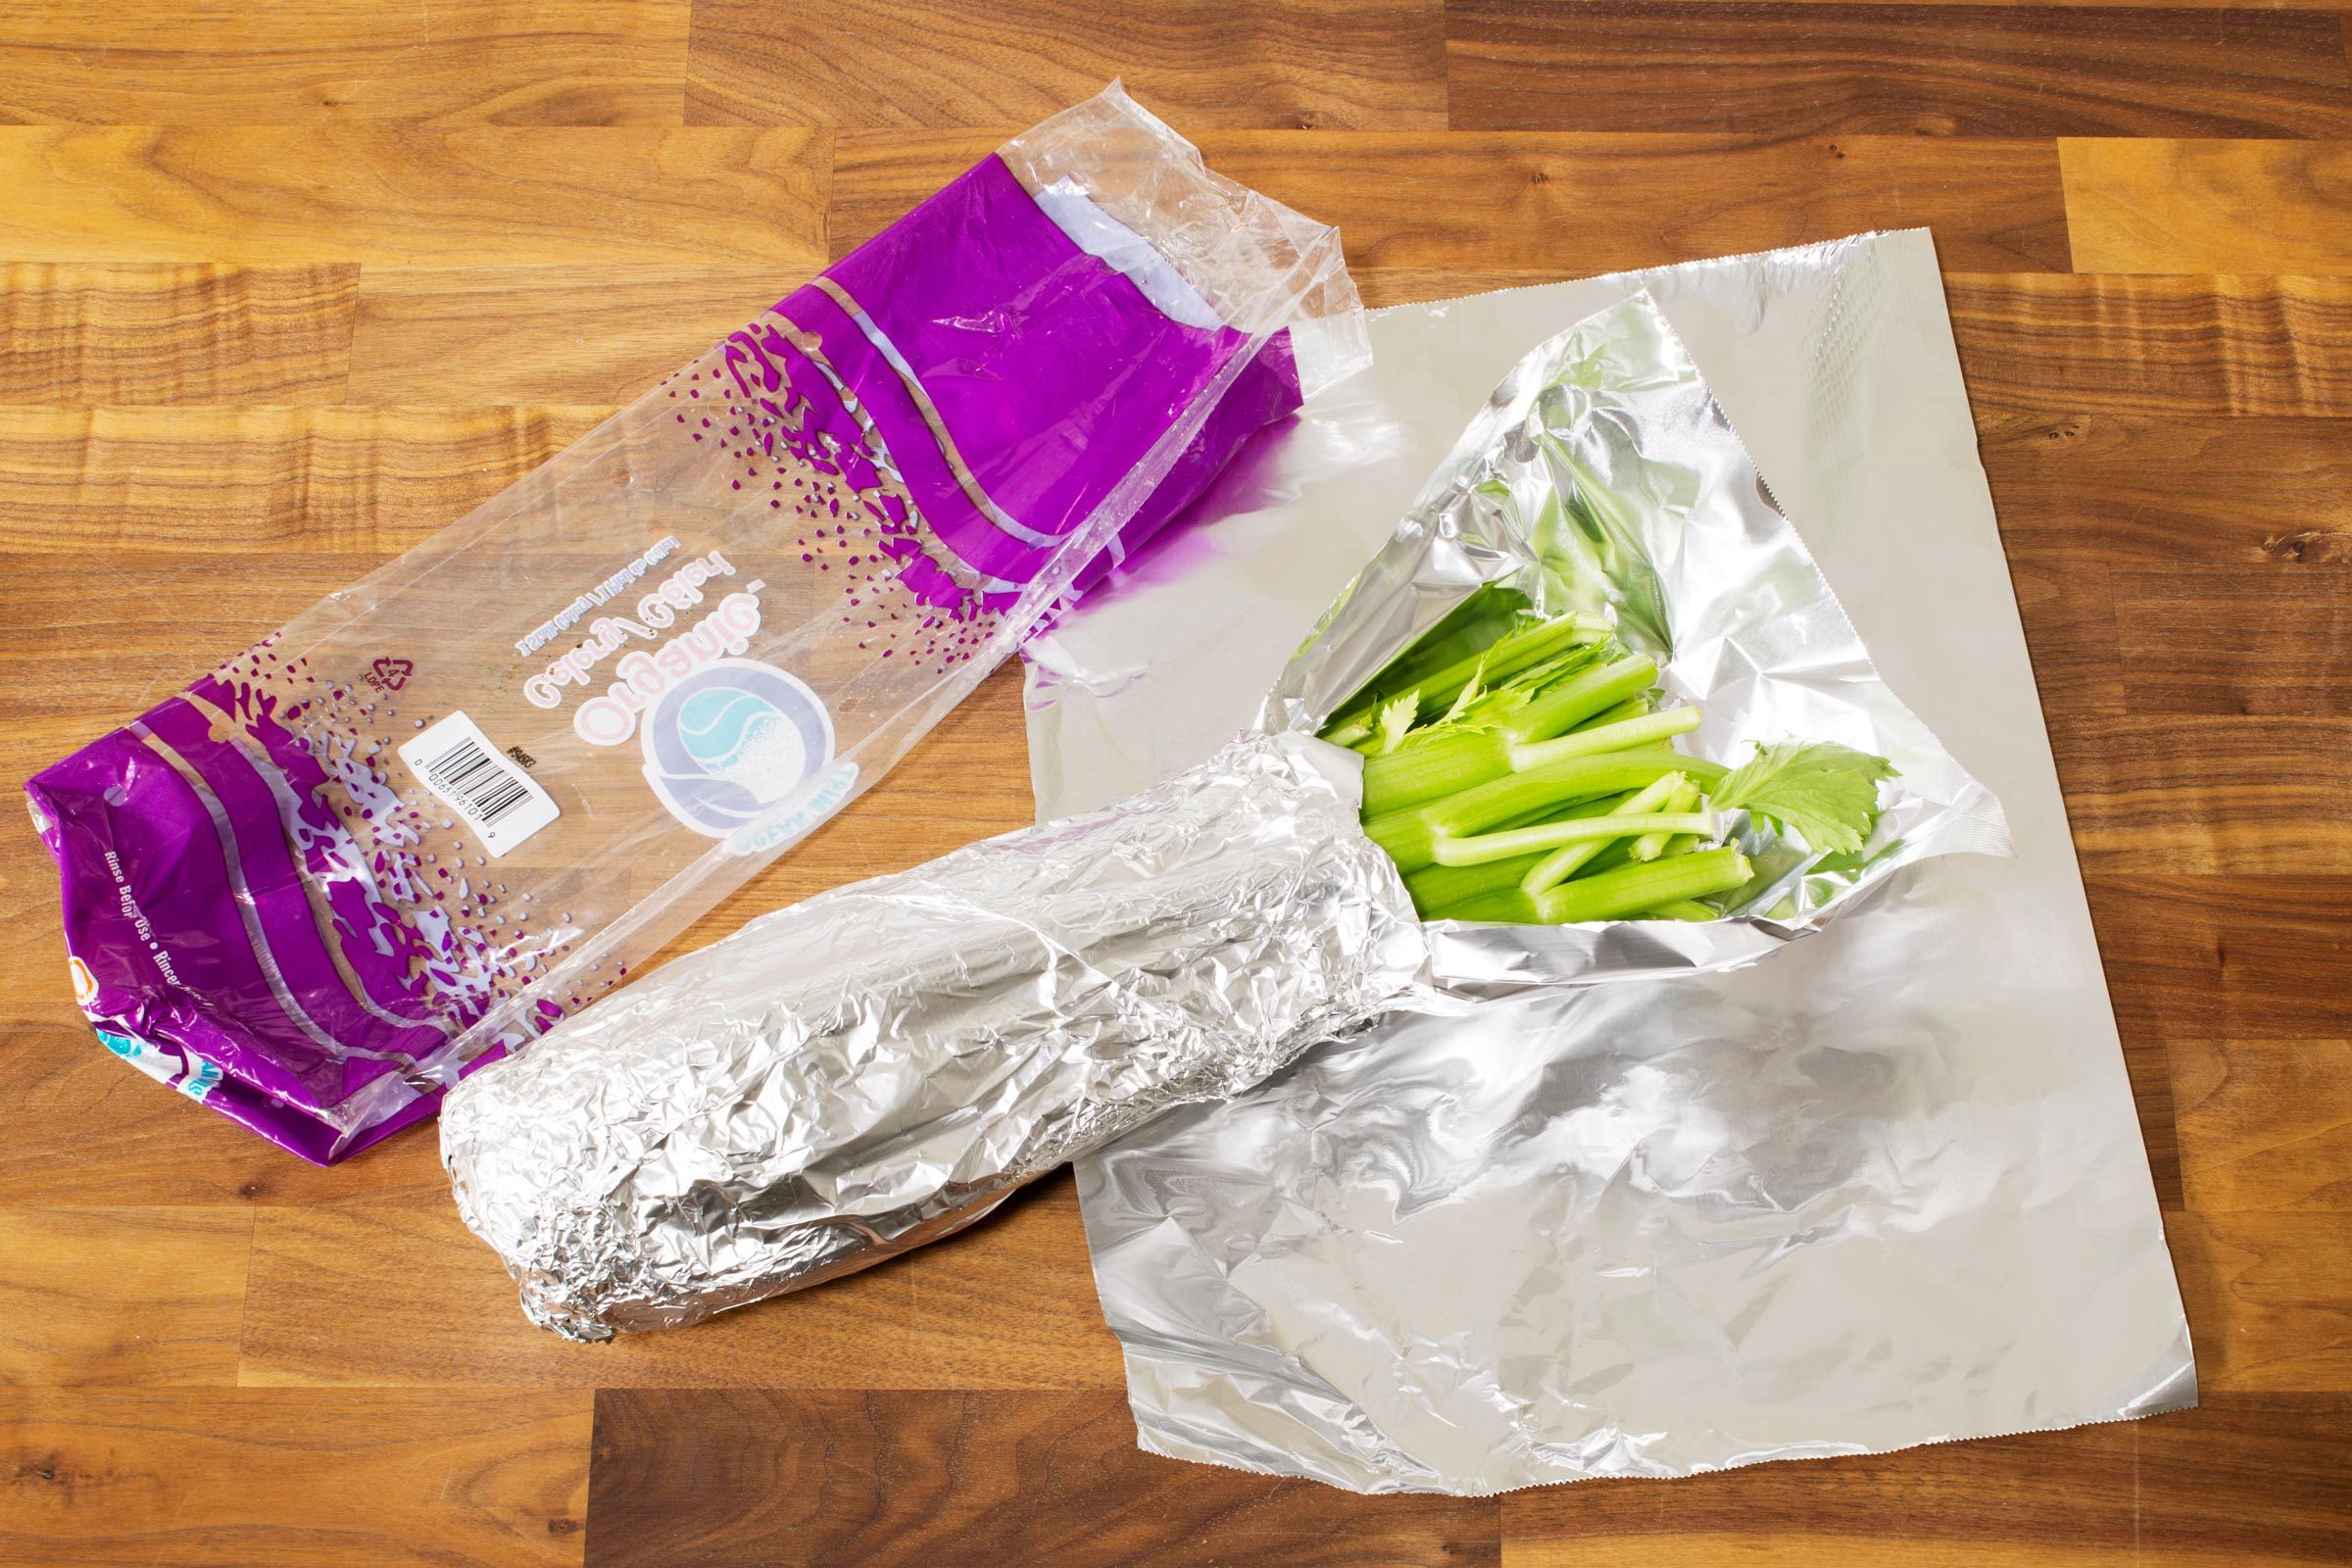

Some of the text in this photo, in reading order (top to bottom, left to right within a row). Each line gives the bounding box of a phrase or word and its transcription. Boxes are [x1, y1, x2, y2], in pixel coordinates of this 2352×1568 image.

[364, 672, 385, 693] LDPE
[387, 668, 399, 677] 4
[105, 851, 124, 883] Rinse
[135, 918, 151, 941] Use
[153, 951, 180, 985] Rincer
